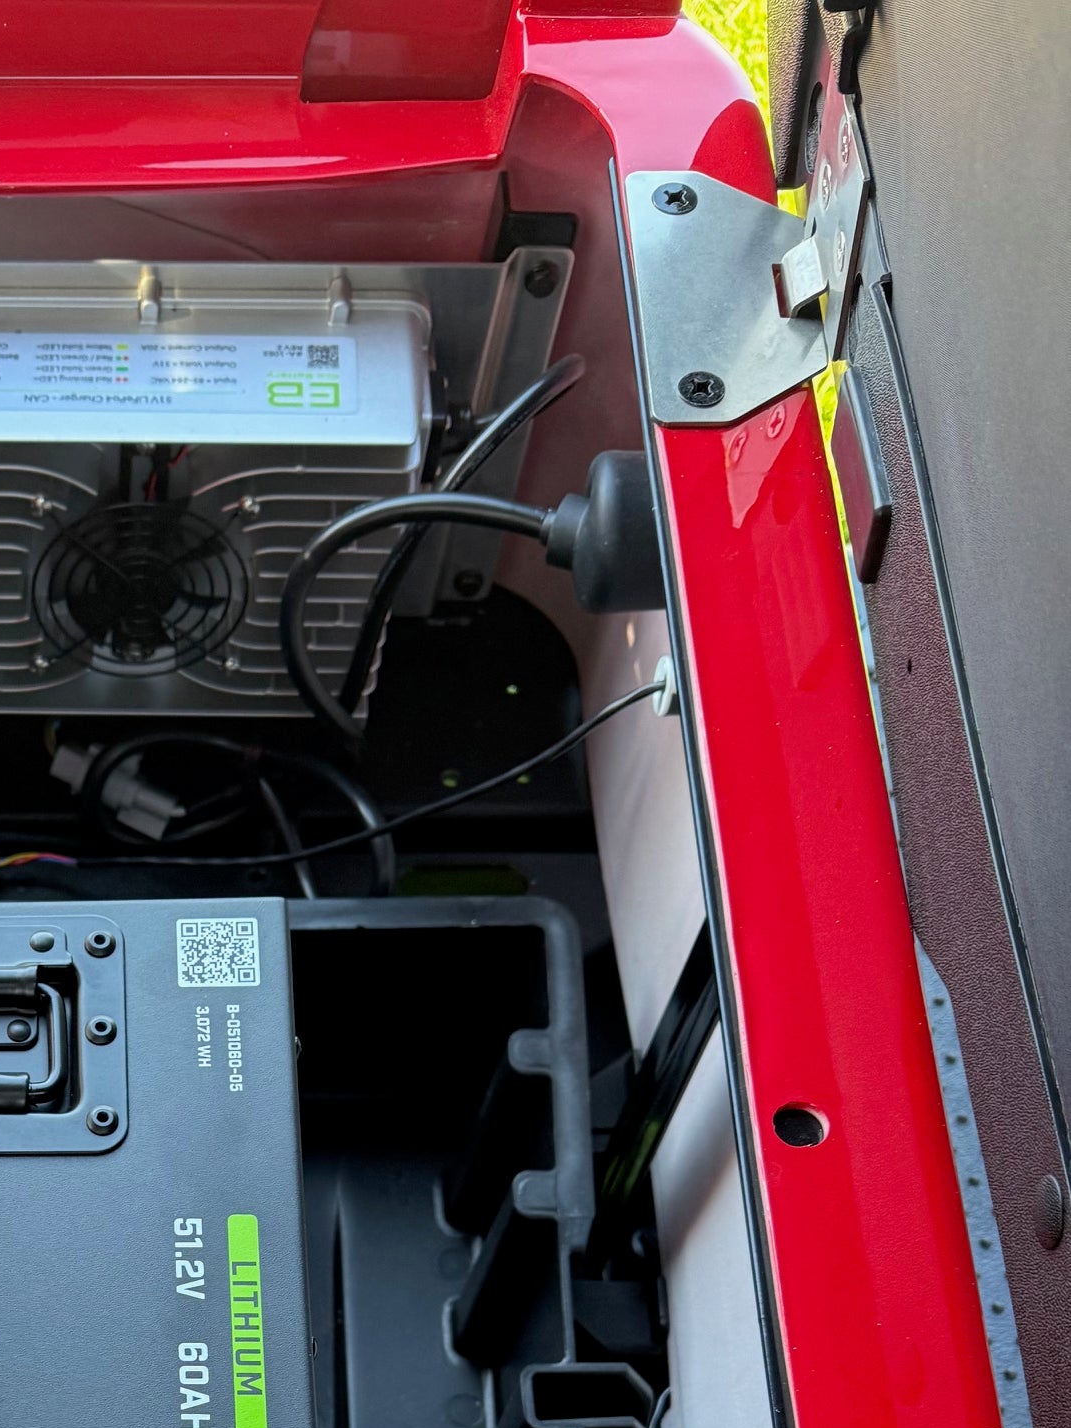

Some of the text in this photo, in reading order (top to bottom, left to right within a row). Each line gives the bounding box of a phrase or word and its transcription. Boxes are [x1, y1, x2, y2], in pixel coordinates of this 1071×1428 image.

[23, 394, 49, 403] CAN
[59, 394, 103, 403] Charger
[195, 1006, 212, 1067] 3,072 WH
[226, 1005, 242, 1091] B-051060-05
[173, 1218, 205, 1299] 51.2V
[231, 1260, 262, 1396] LITHIUM
